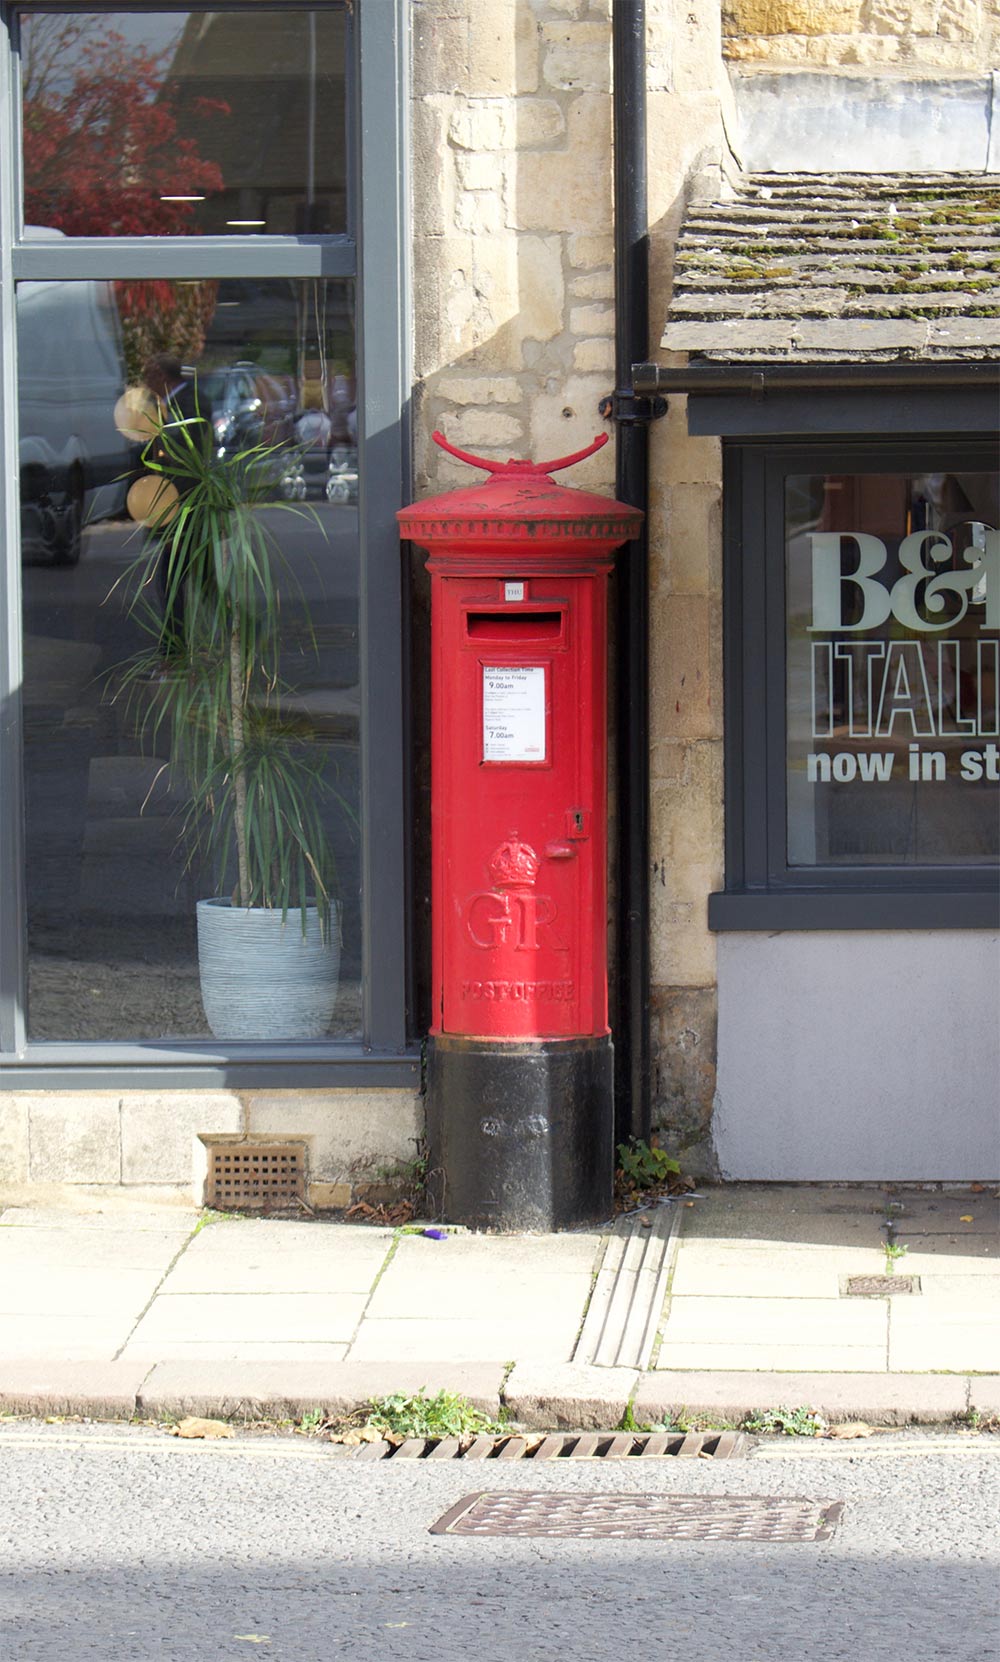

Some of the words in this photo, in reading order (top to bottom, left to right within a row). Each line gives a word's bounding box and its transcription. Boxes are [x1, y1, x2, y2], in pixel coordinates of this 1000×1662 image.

[807, 752, 895, 782] now
[908, 743, 947, 781] in
[463, 981, 511, 1000] POST
[514, 981, 574, 1001] OFFICE
